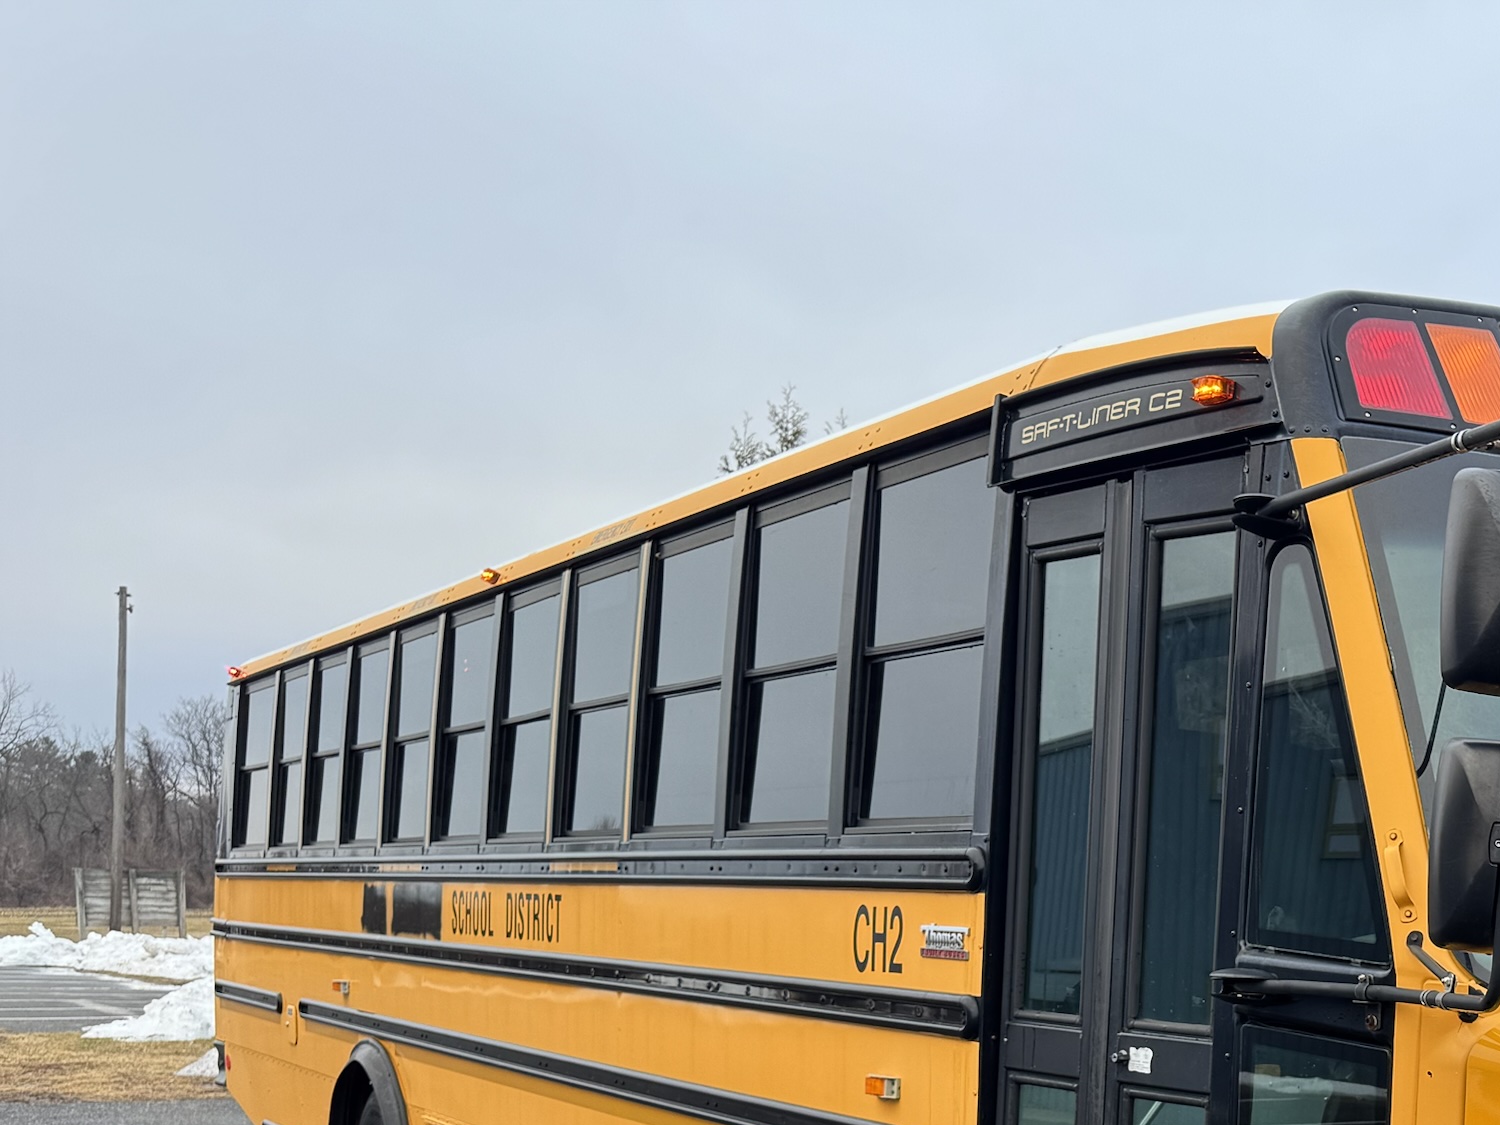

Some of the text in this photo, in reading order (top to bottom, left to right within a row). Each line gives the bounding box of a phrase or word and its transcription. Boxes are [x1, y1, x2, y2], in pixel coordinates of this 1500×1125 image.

[1148, 388, 1183, 413] C2
[451, 890, 562, 943] SCHOOL DISTRICT
[853, 904, 904, 974] CH2
